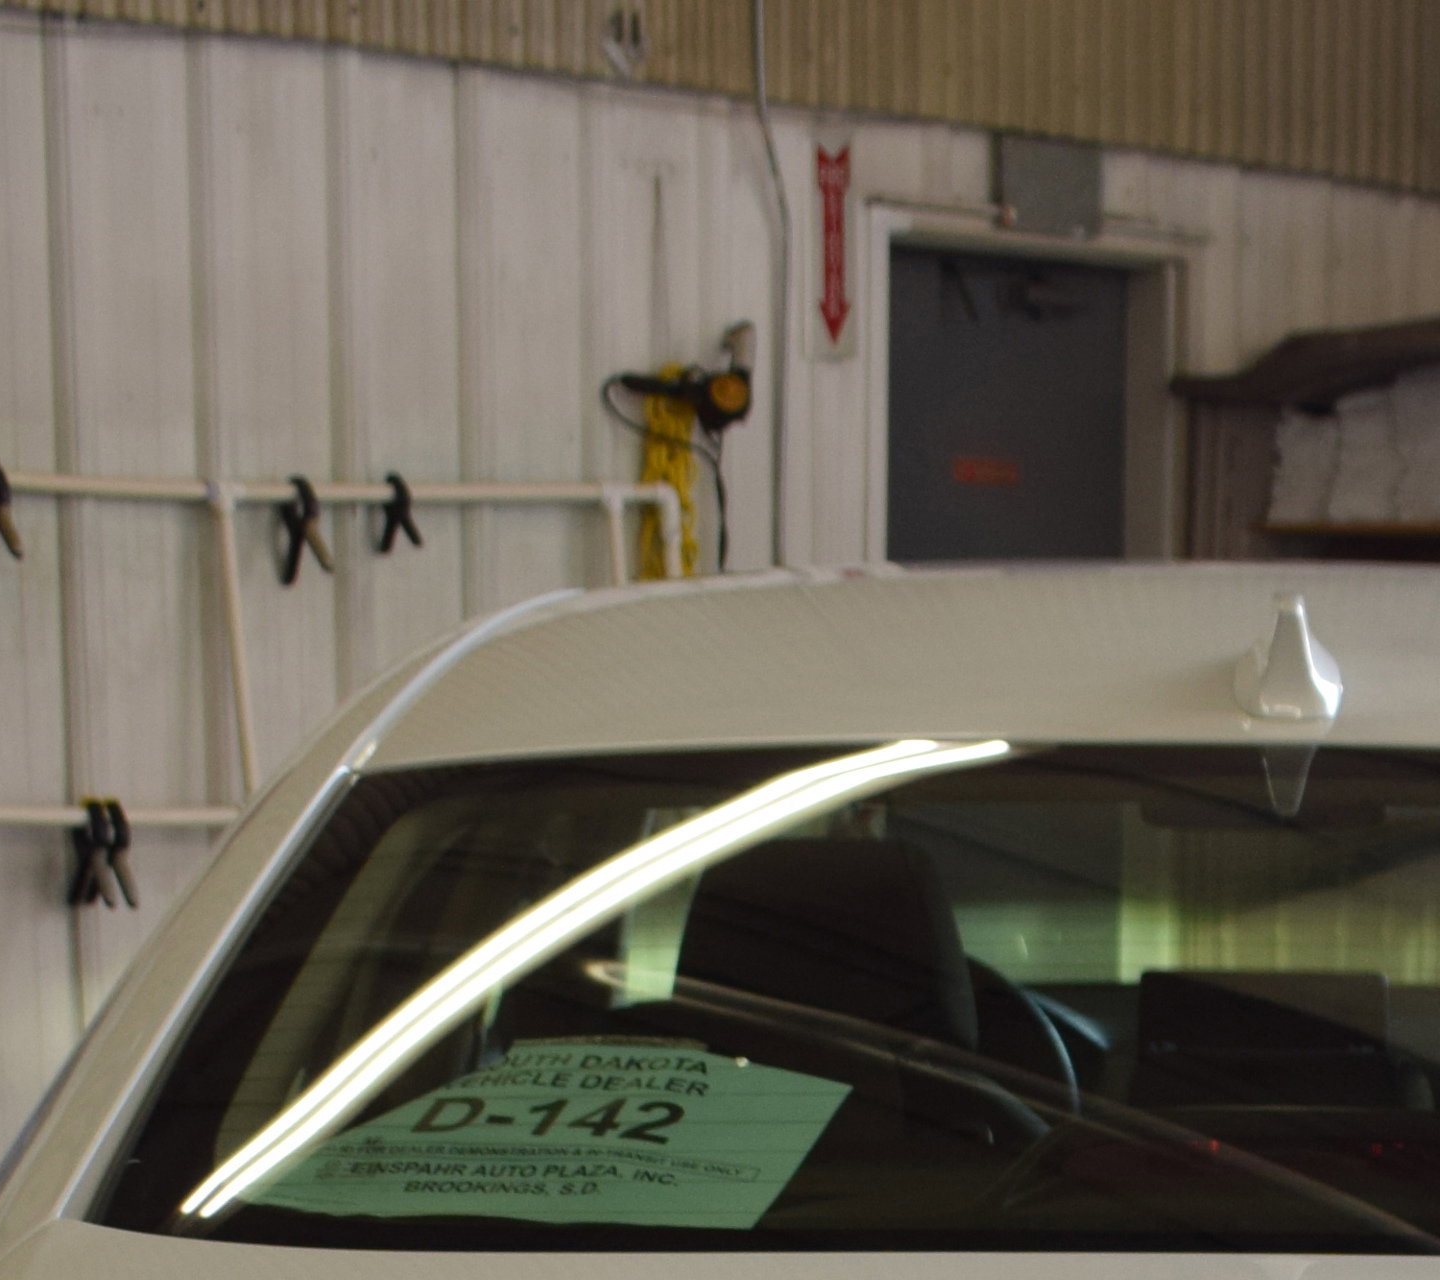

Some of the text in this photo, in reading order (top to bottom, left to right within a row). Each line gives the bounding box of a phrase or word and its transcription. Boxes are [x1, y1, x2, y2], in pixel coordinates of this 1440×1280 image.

[580, 1054, 709, 1076] DAKOTA
[579, 1072, 710, 1097] DEALER
[411, 1096, 685, 1145] D-142
[471, 1164, 537, 1178] AUTO
